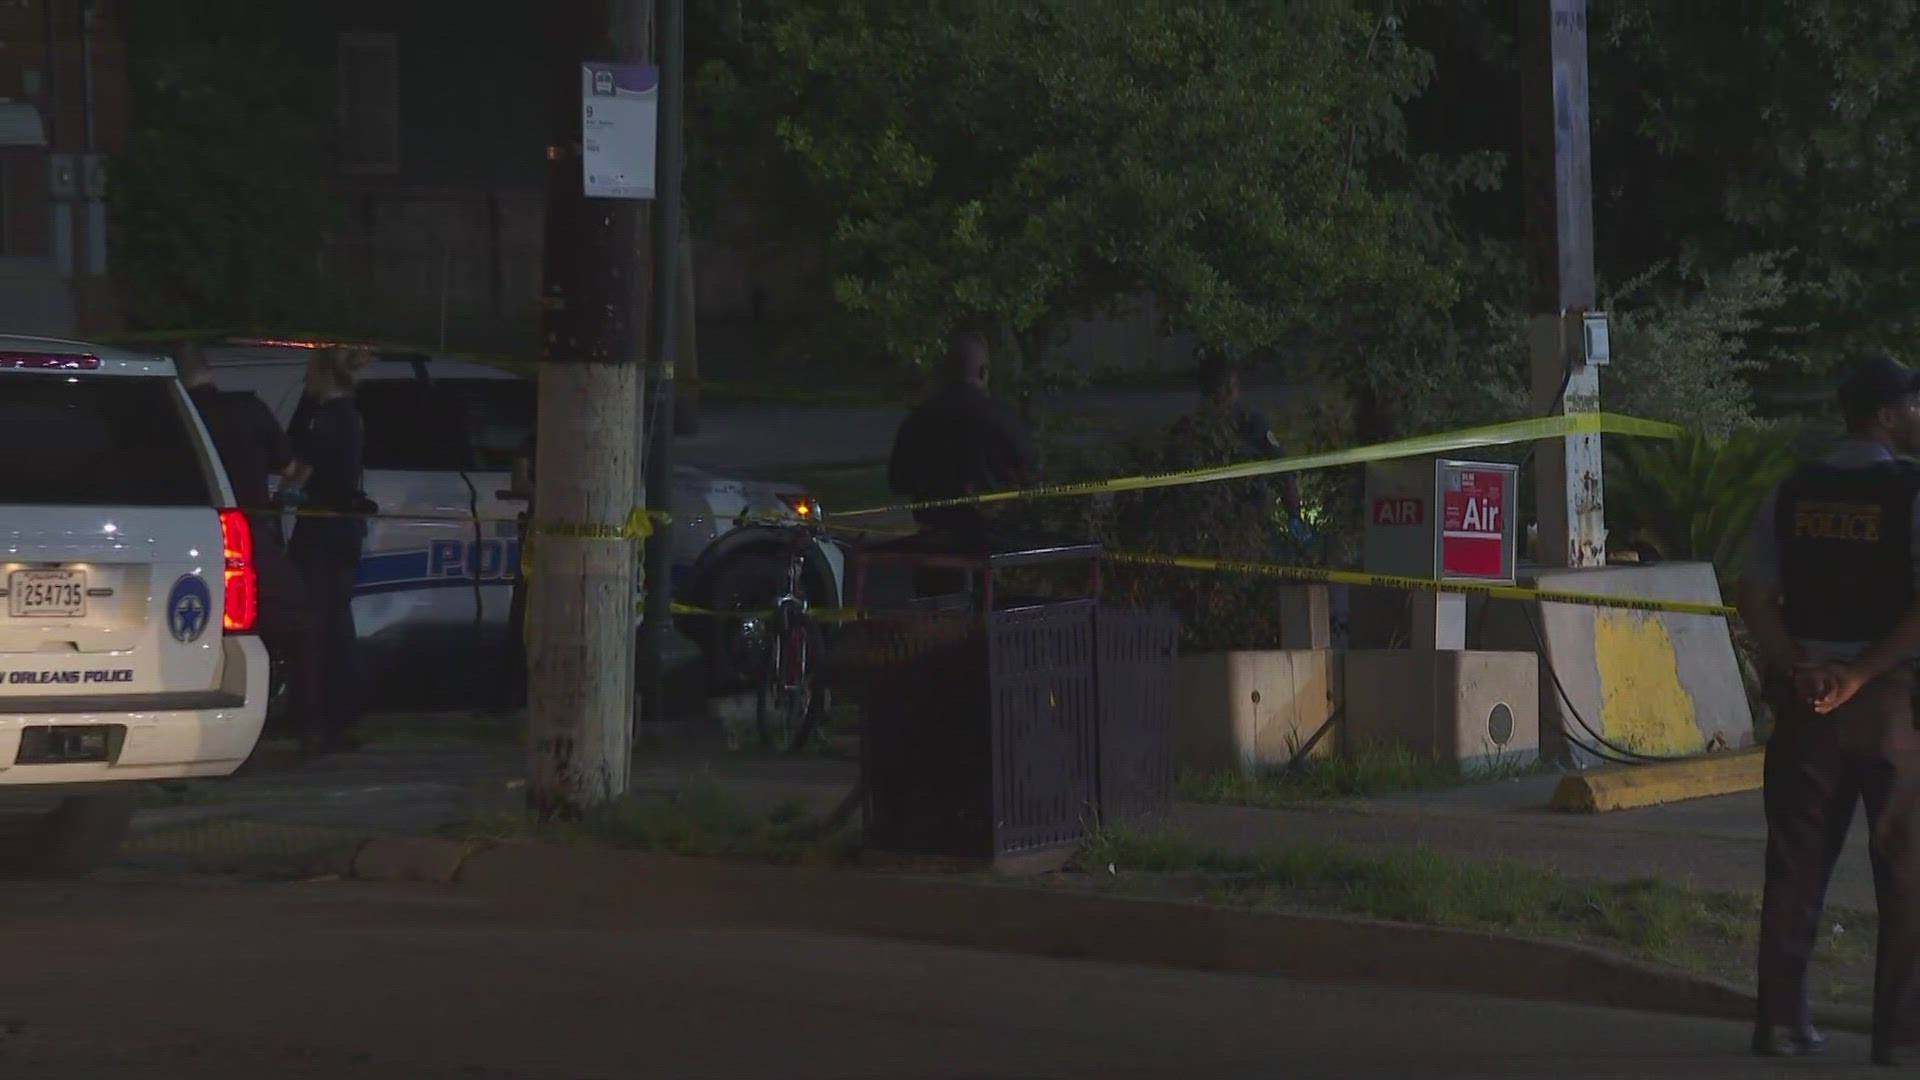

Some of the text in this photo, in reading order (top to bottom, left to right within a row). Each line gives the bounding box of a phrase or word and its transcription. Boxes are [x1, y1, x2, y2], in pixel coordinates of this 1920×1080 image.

[586, 105, 593, 118] 9
[1378, 501, 1418, 523] AIR
[1462, 496, 1499, 531] Air
[1794, 511, 1881, 541] POLICE
[25, 584, 81, 606] 254735
[9, 671, 80, 684] ORLEANS
[84, 669, 133, 682] POLICE
